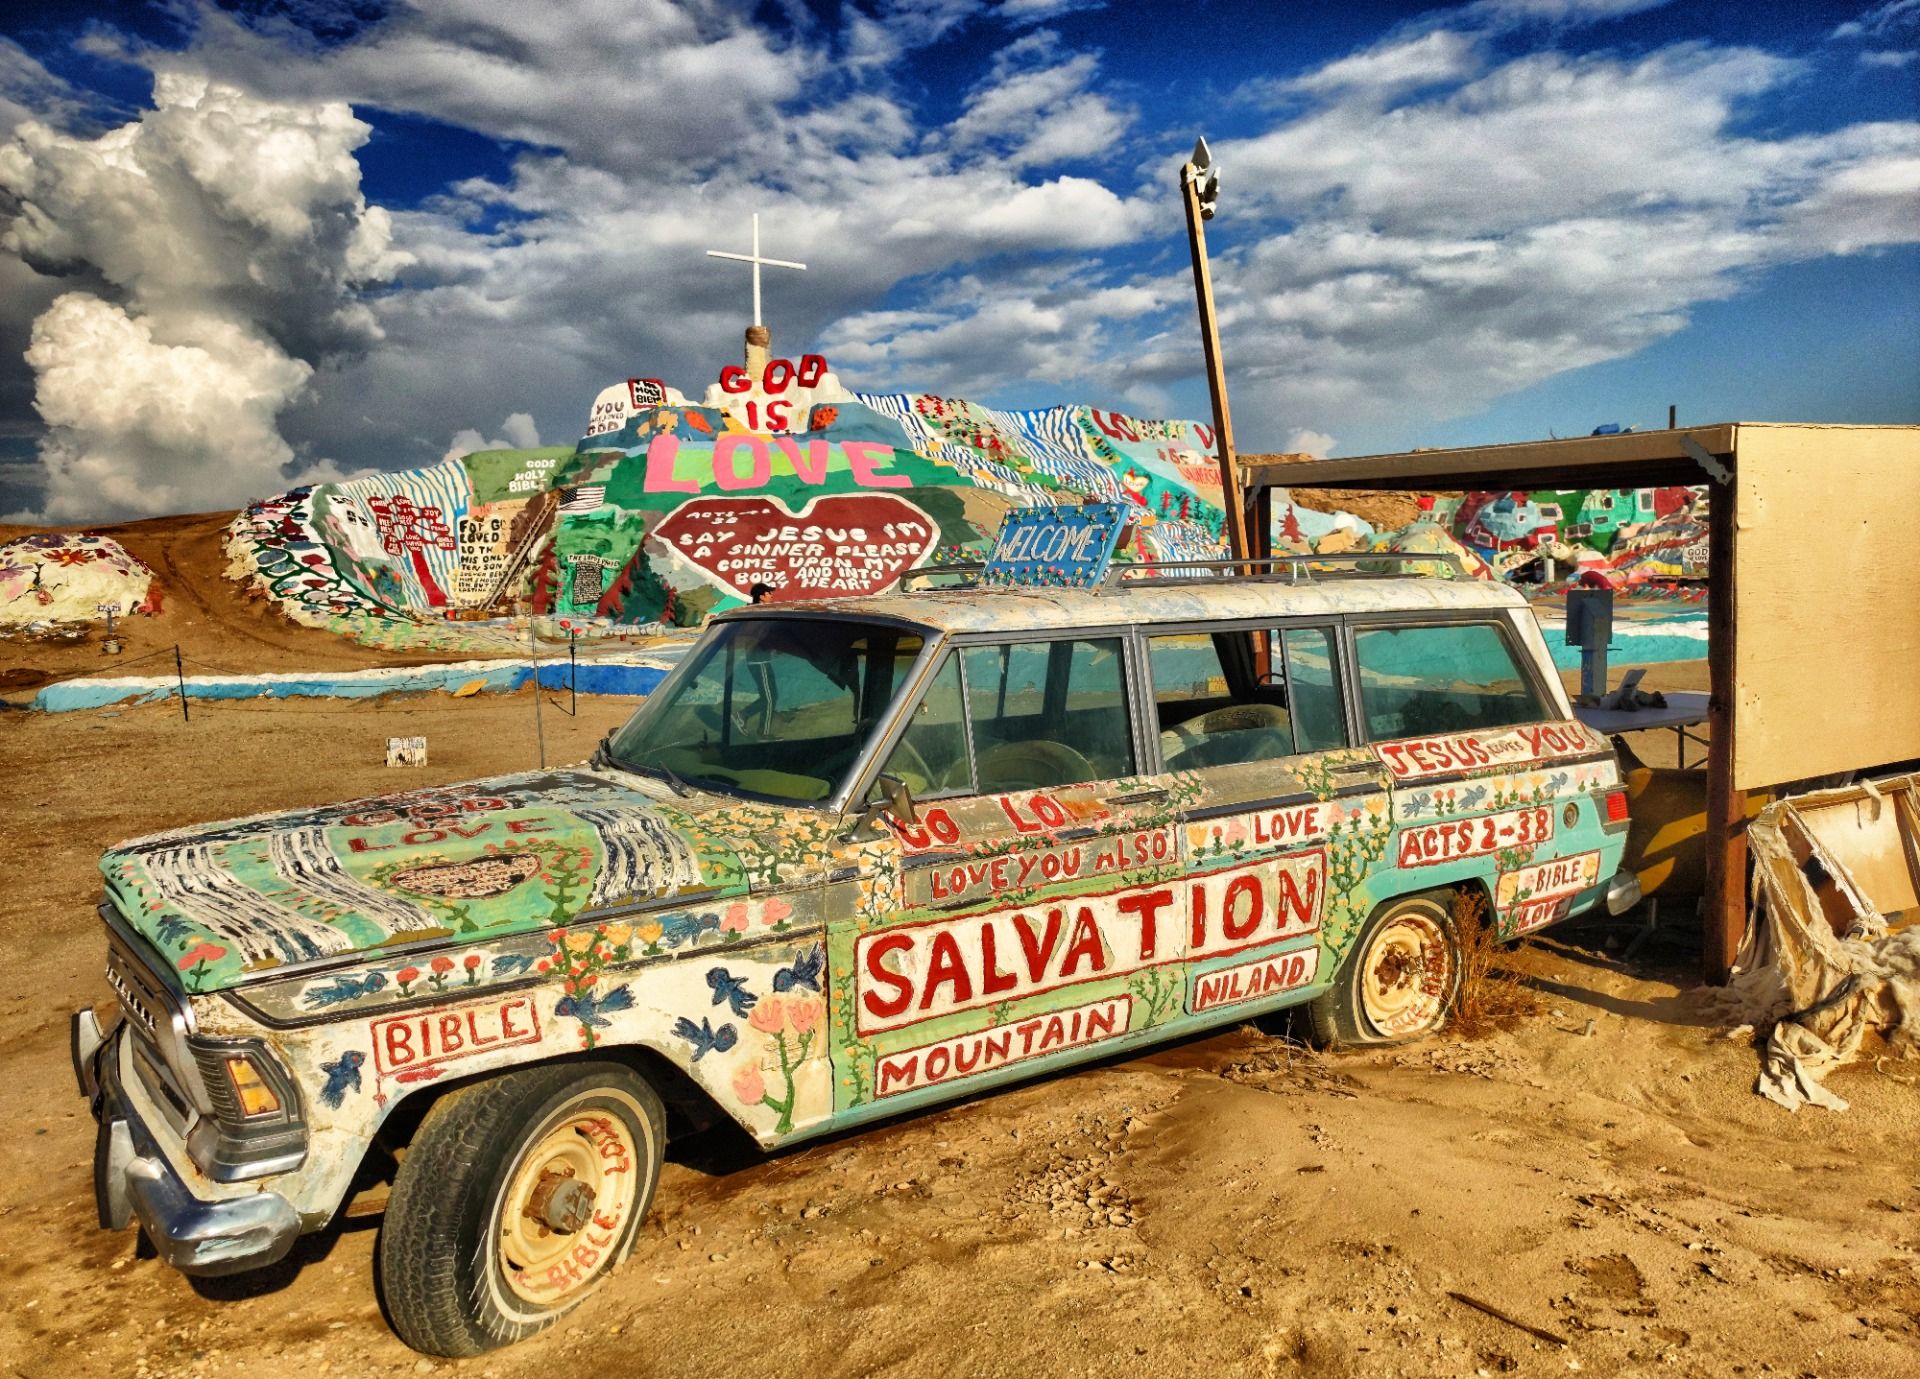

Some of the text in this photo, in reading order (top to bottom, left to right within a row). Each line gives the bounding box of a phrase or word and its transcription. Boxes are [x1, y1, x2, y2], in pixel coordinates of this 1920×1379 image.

[719, 354, 828, 394] GOD
[596, 401, 625, 415] YOU
[746, 400, 793, 431] IS
[515, 470, 545, 480] HOLY
[526, 459, 556, 468] GODS
[643, 434, 914, 494] LOVE
[424, 509, 439, 517] JOY
[460, 532, 500, 543] LOVED
[679, 531, 736, 545] SAY
[755, 526, 868, 542] JESUS
[993, 524, 1104, 562] WELCOME
[461, 556, 478, 564] HIS
[693, 542, 921, 558] A SINNER PLEASE
[1688, 548, 1708, 557] GOD
[716, 557, 903, 571] COME UPON MY
[734, 567, 882, 585] BODY AND INTO
[800, 578, 871, 590] HEART
[1382, 737, 1490, 775] JESUS
[341, 799, 508, 827] GOD
[348, 817, 555, 853] LOVE
[1399, 808, 1549, 863] ACTS 2-38
[932, 856, 1010, 900] LOVE
[1016, 846, 1081, 887] YOU
[862, 865, 1317, 1019] SALVATION
[385, 1000, 529, 1067] BIBLE
[880, 1003, 1117, 1093] MOUNTAIN
